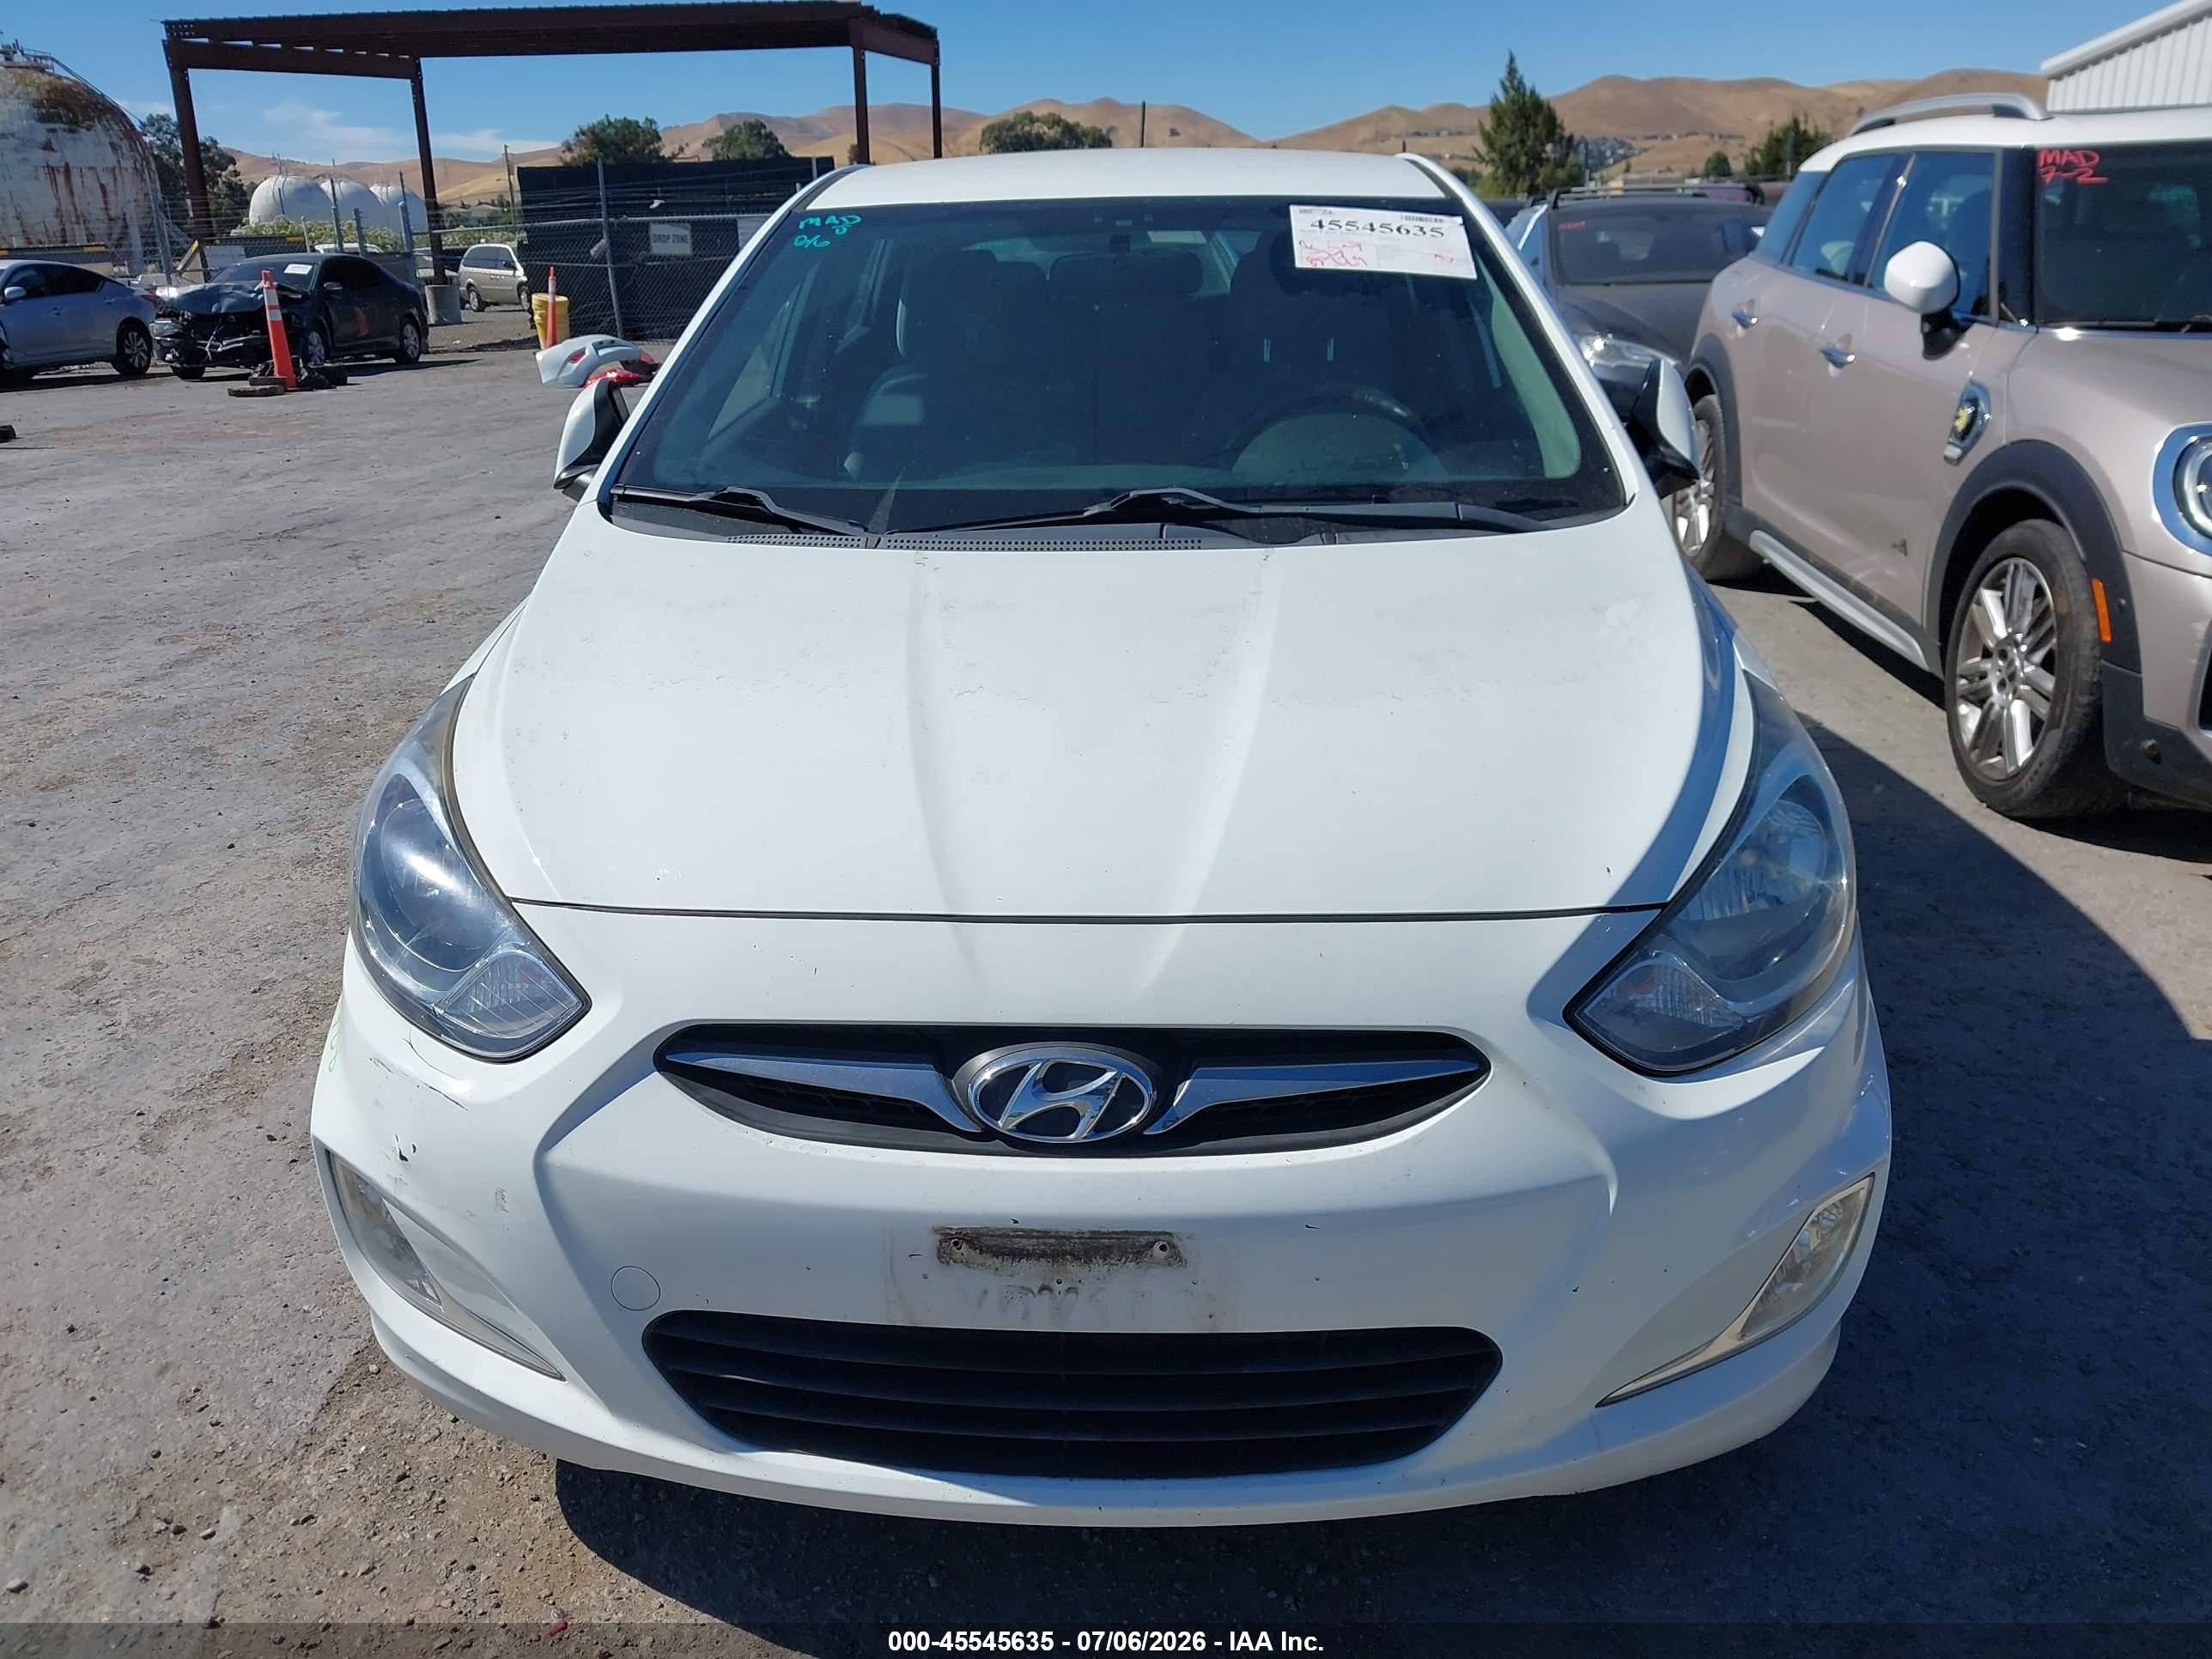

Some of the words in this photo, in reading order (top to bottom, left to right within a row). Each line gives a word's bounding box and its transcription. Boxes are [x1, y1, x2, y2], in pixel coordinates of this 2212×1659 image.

[2038, 149, 2100, 167] MAD
[799, 216, 861, 229] MAD
[1310, 218, 1445, 238] 45545635
